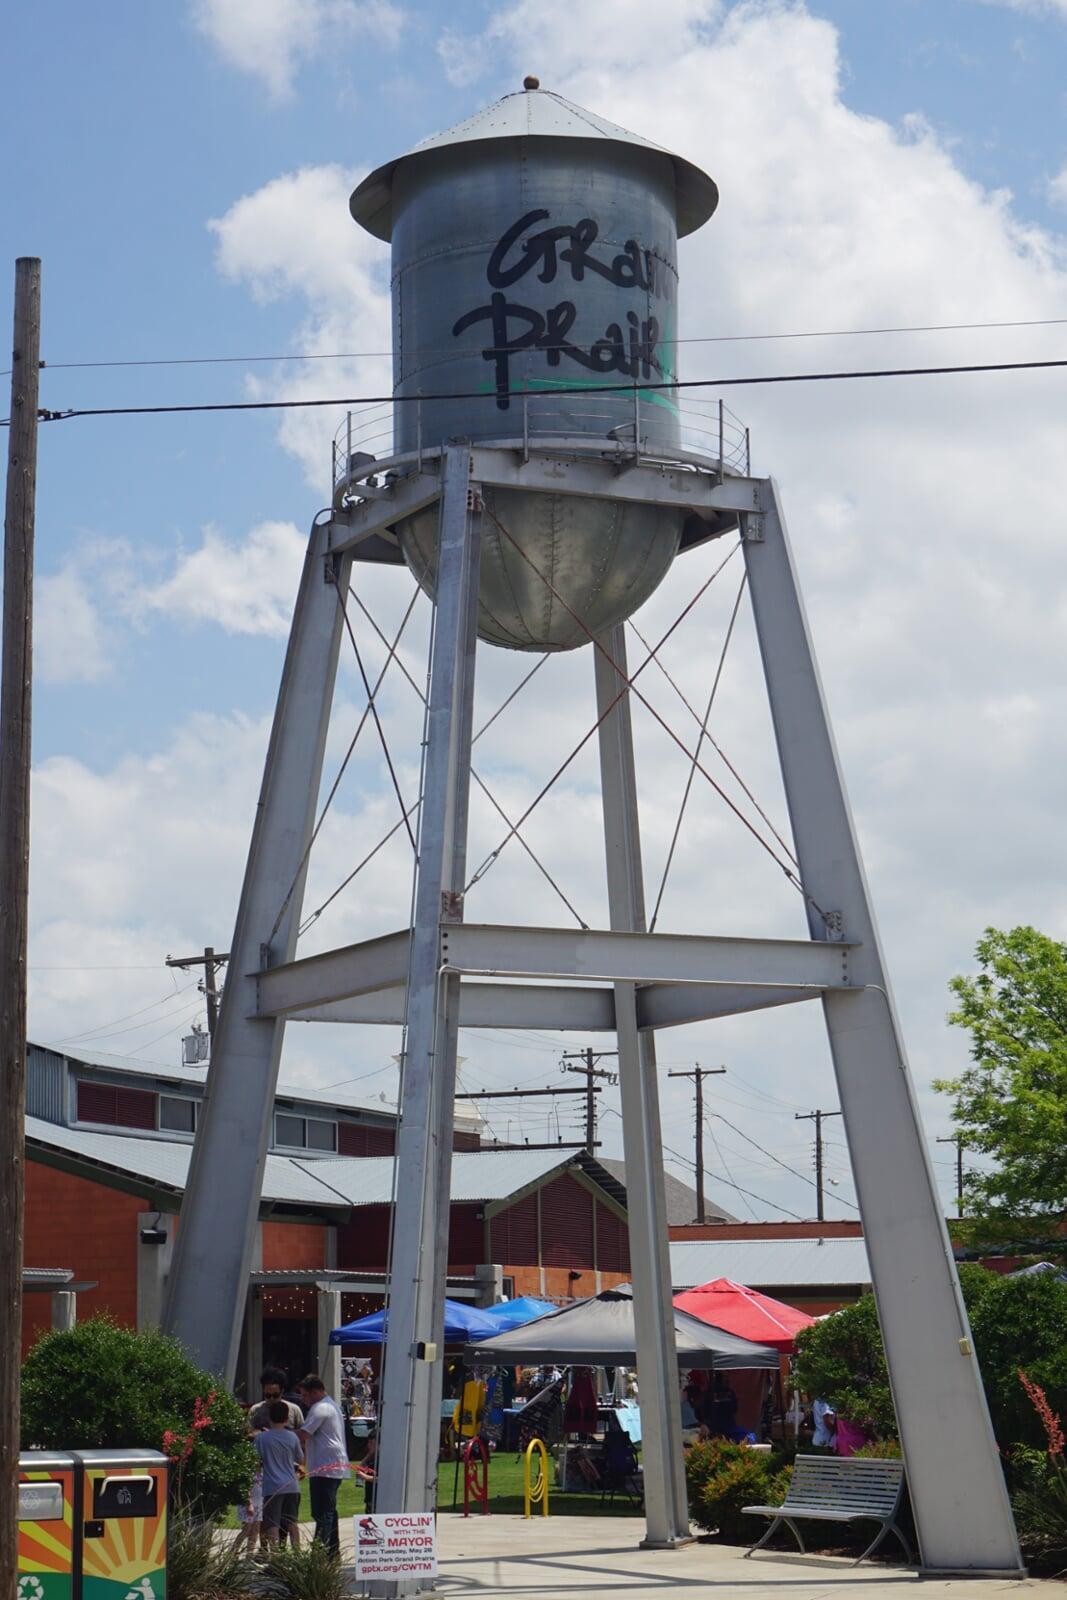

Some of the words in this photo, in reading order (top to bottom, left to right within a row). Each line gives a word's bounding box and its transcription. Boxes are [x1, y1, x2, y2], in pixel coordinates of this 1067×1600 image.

[384, 1517, 432, 1527] CYCLIN'
[387, 1537, 433, 1547] MAYOR
[361, 1563, 432, 1573] gptx.org/CWTM
